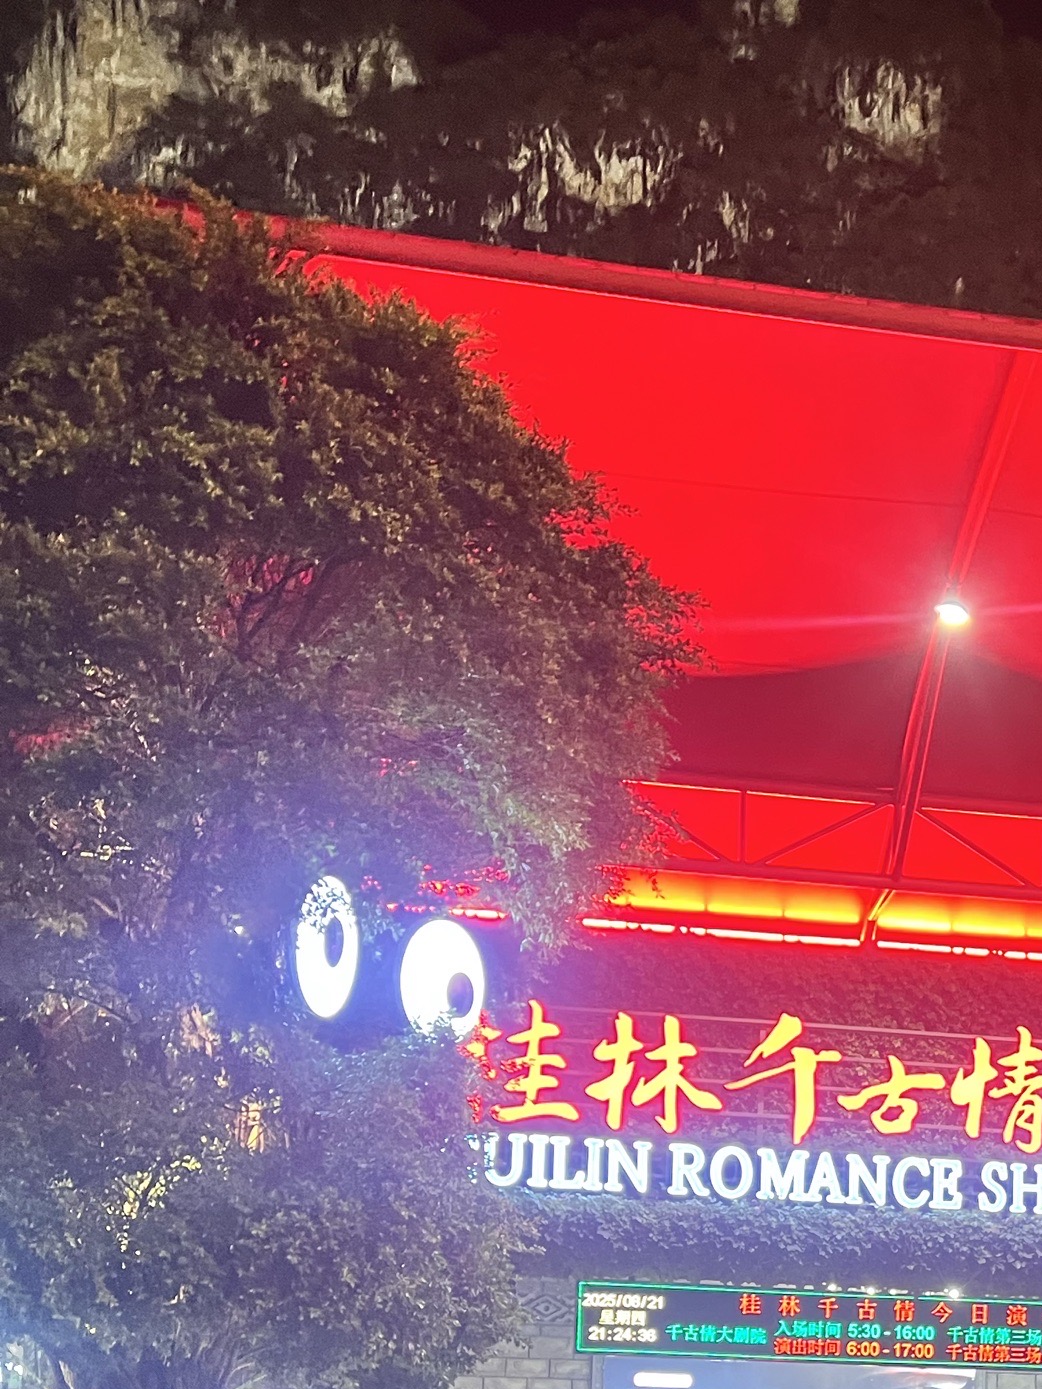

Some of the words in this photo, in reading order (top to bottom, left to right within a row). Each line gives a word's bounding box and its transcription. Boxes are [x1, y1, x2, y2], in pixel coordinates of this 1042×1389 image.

[666, 1142, 963, 1211] ROMANCE
[599, 1309, 647, 1327] 星期四
[665, 1323, 768, 1345] 千古情大剧院
[774, 1320, 842, 1338] 入场时间
[773, 1338, 842, 1356] 演出时间
